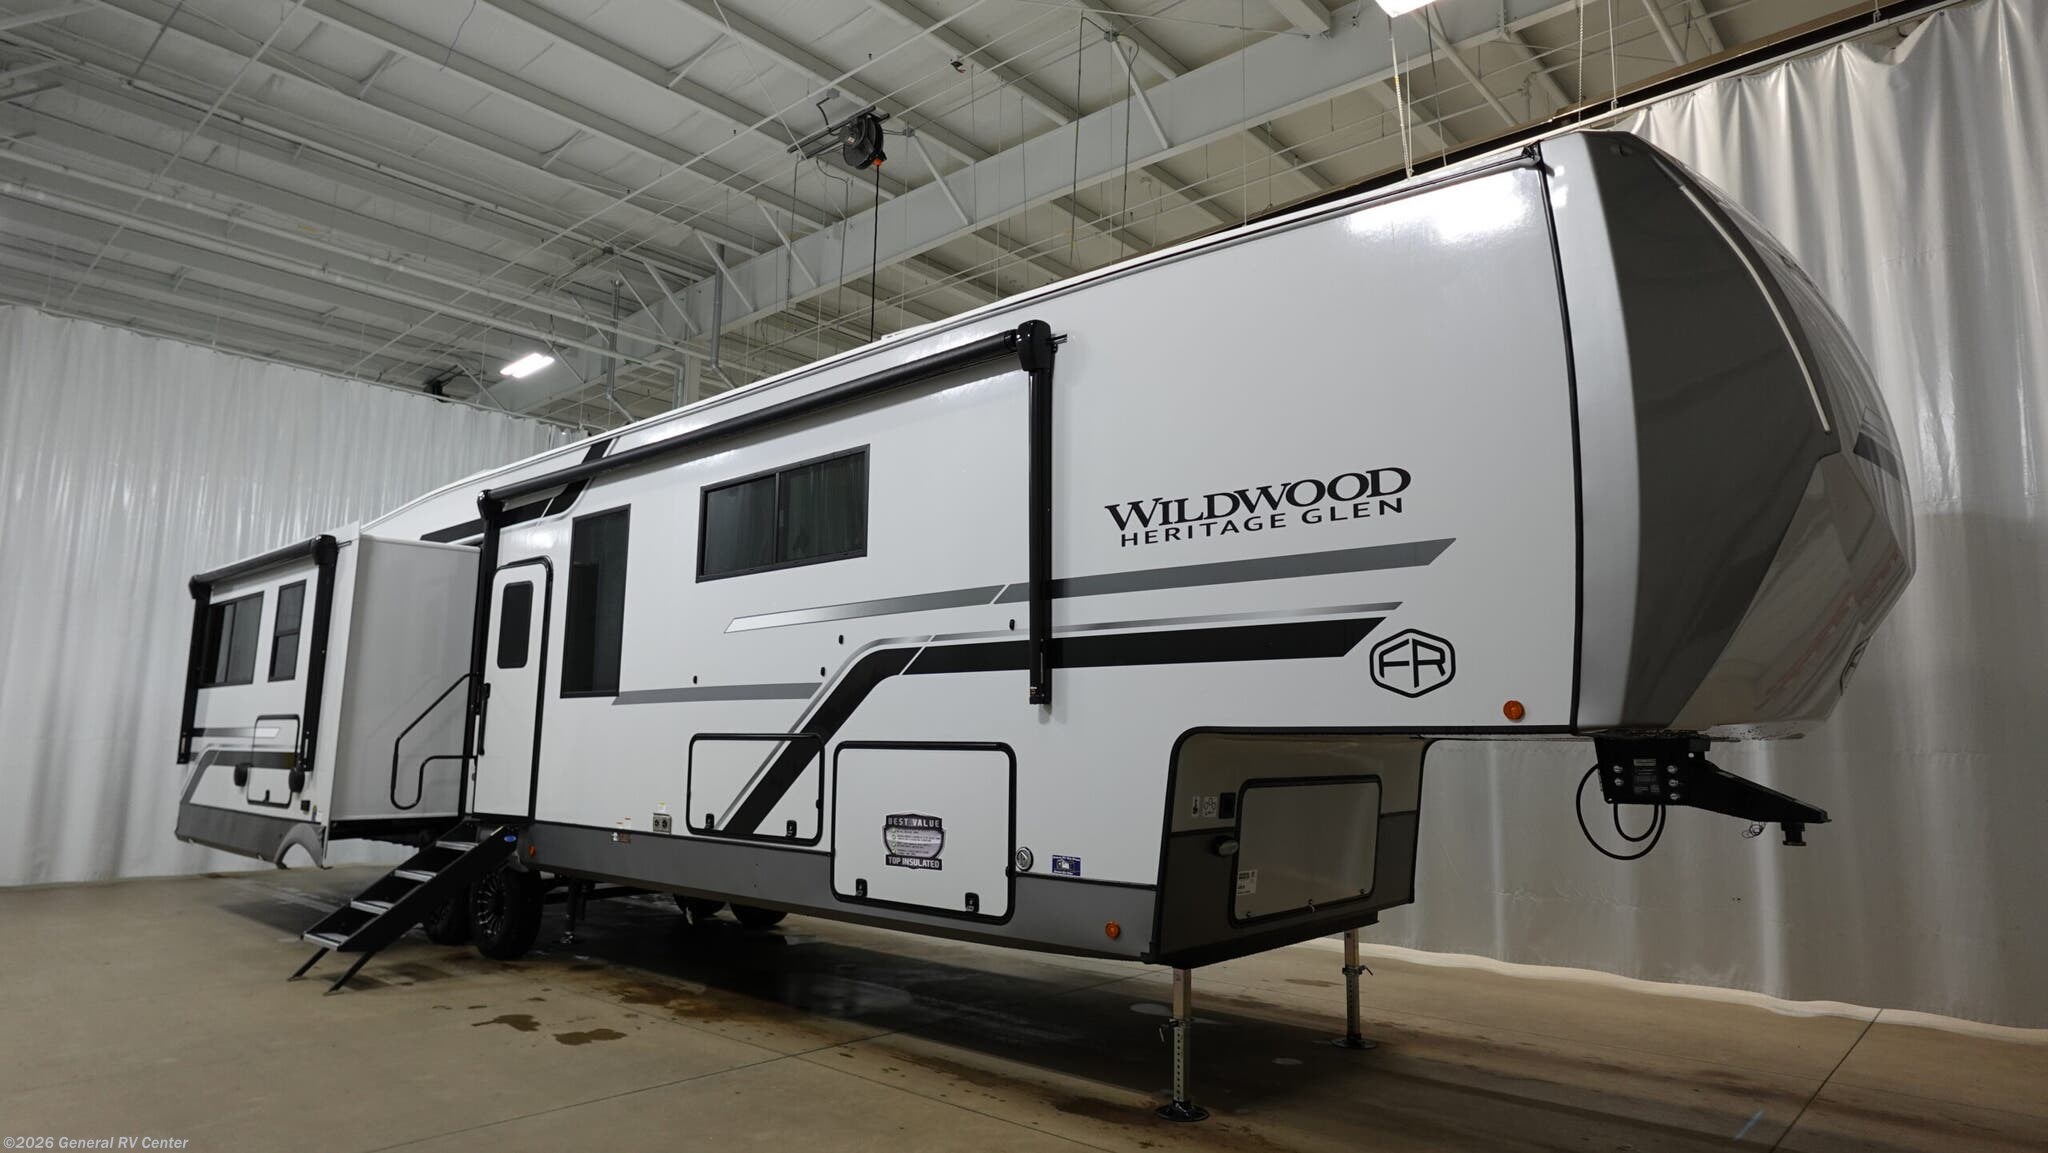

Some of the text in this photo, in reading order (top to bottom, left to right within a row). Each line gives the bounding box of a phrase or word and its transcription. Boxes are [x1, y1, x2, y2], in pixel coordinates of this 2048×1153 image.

[1105, 467, 1411, 531] WILDWOOD
[1121, 497, 1402, 547] HERITAGE GLEN
[1379, 637, 1446, 688] FR
[913, 819, 940, 828] VALUE
[888, 856, 940, 868] TOP INSULATED
